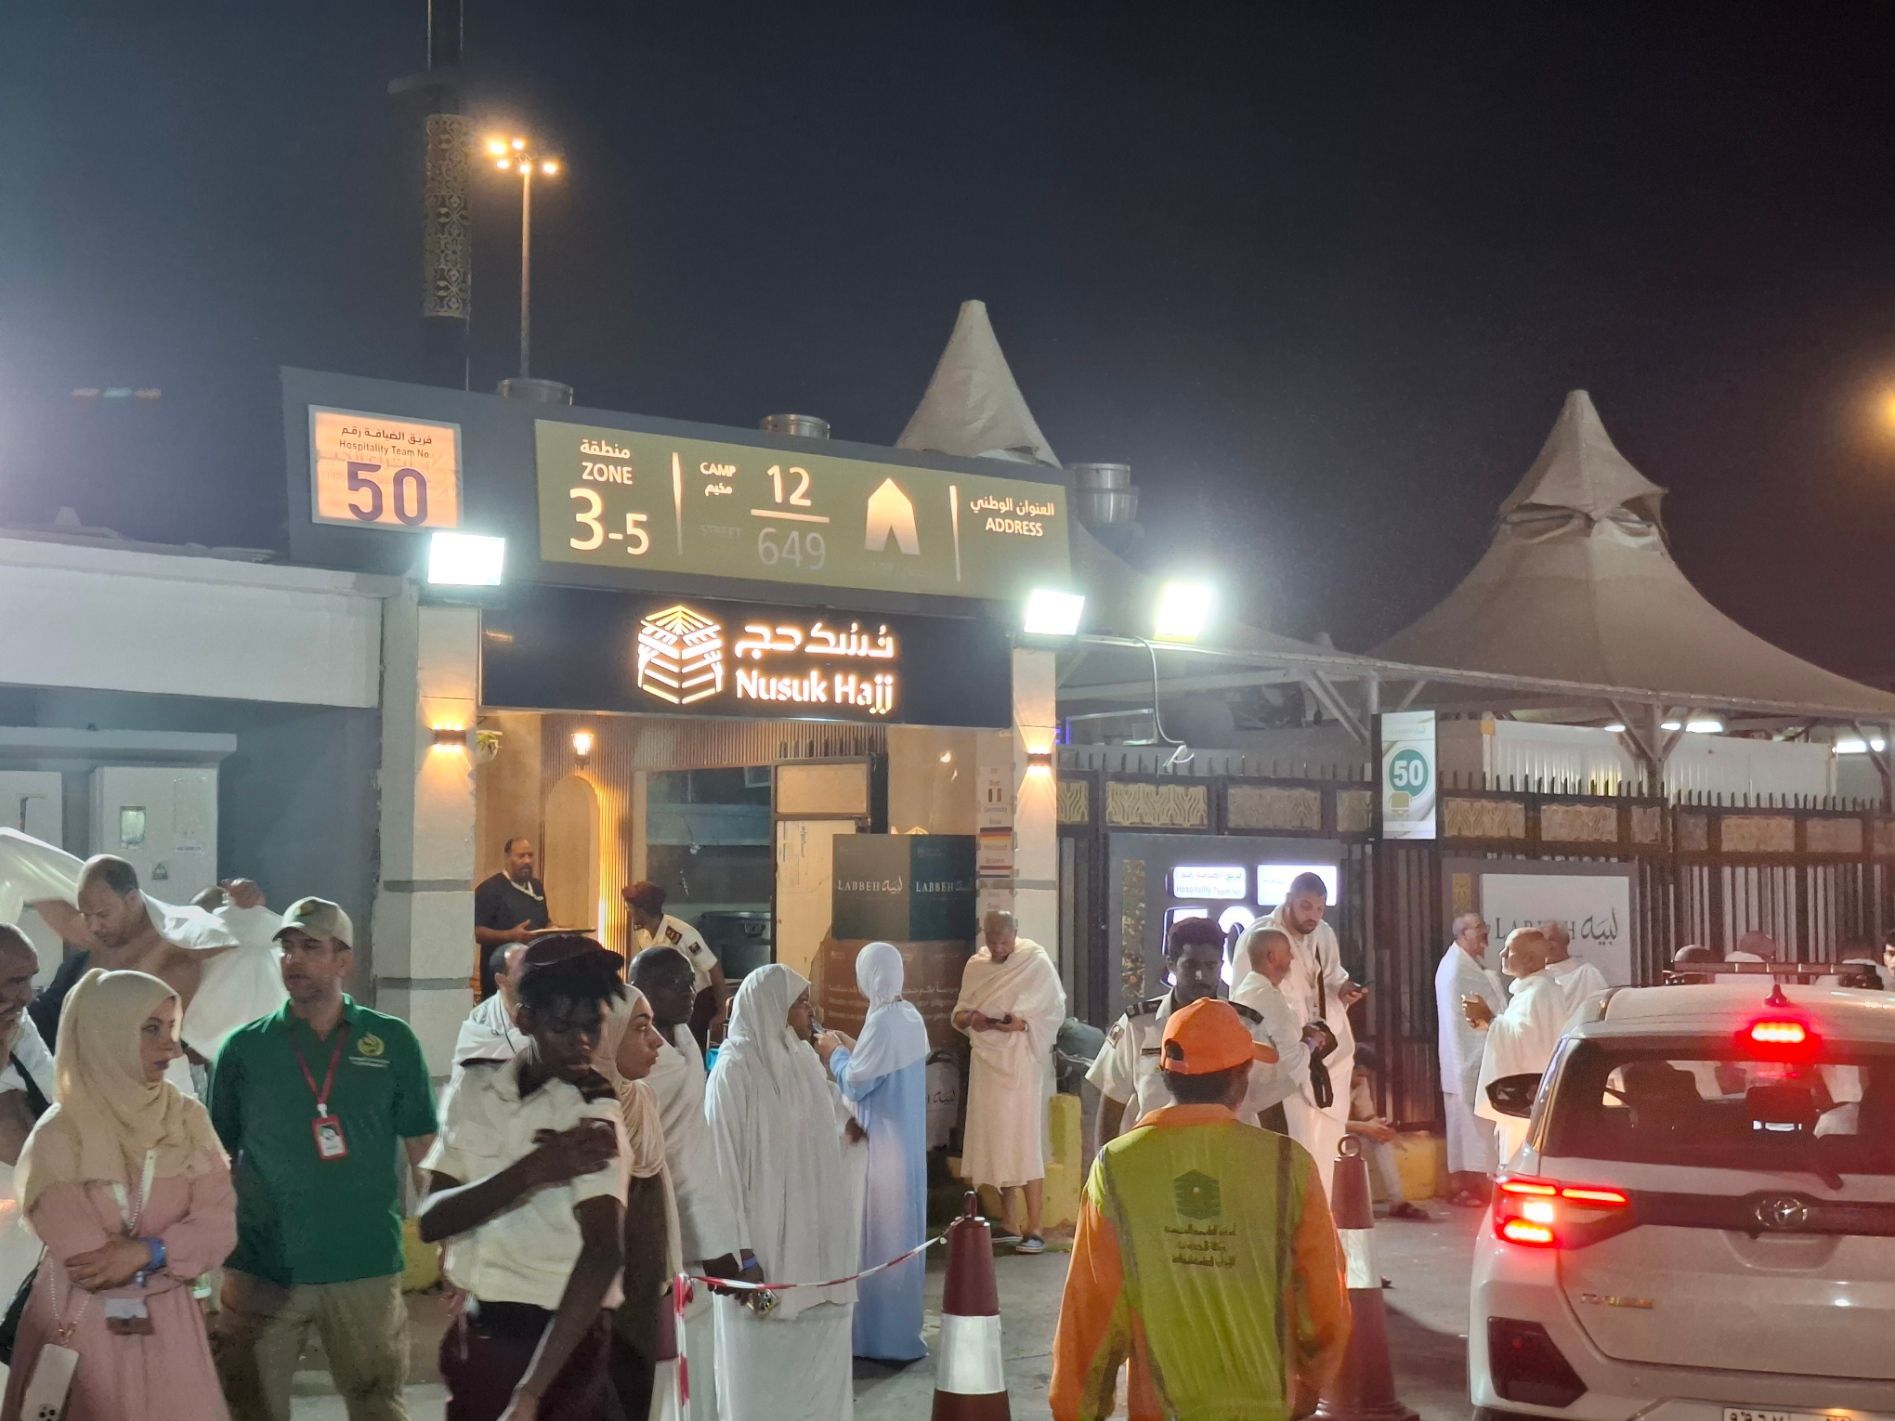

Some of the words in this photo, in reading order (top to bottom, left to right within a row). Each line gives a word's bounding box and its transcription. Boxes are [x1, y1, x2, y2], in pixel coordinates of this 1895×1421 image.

[341, 426, 362, 438] رقم
[408, 433, 432, 445] فريق
[339, 439, 389, 456] Hospitality
[391, 446, 415, 457] Team
[580, 438, 631, 459] منطقة
[581, 461, 633, 485] ZONE
[700, 462, 737, 477] CAMP
[347, 461, 429, 527] 50
[704, 482, 733, 497] مخيم
[767, 464, 812, 507] 12
[969, 495, 1014, 514] الوطني
[1016, 500, 1055, 517] العنوان
[569, 487, 650, 555] 3-5
[985, 517, 1044, 537] ADDRESS
[757, 527, 826, 571] 649
[735, 668, 828, 704] Nusuk
[834, 673, 895, 715] Hajj
[1392, 758, 1425, 787] 50
[837, 879, 881, 892] LABBEH
[915, 880, 954, 893] LABBEH
